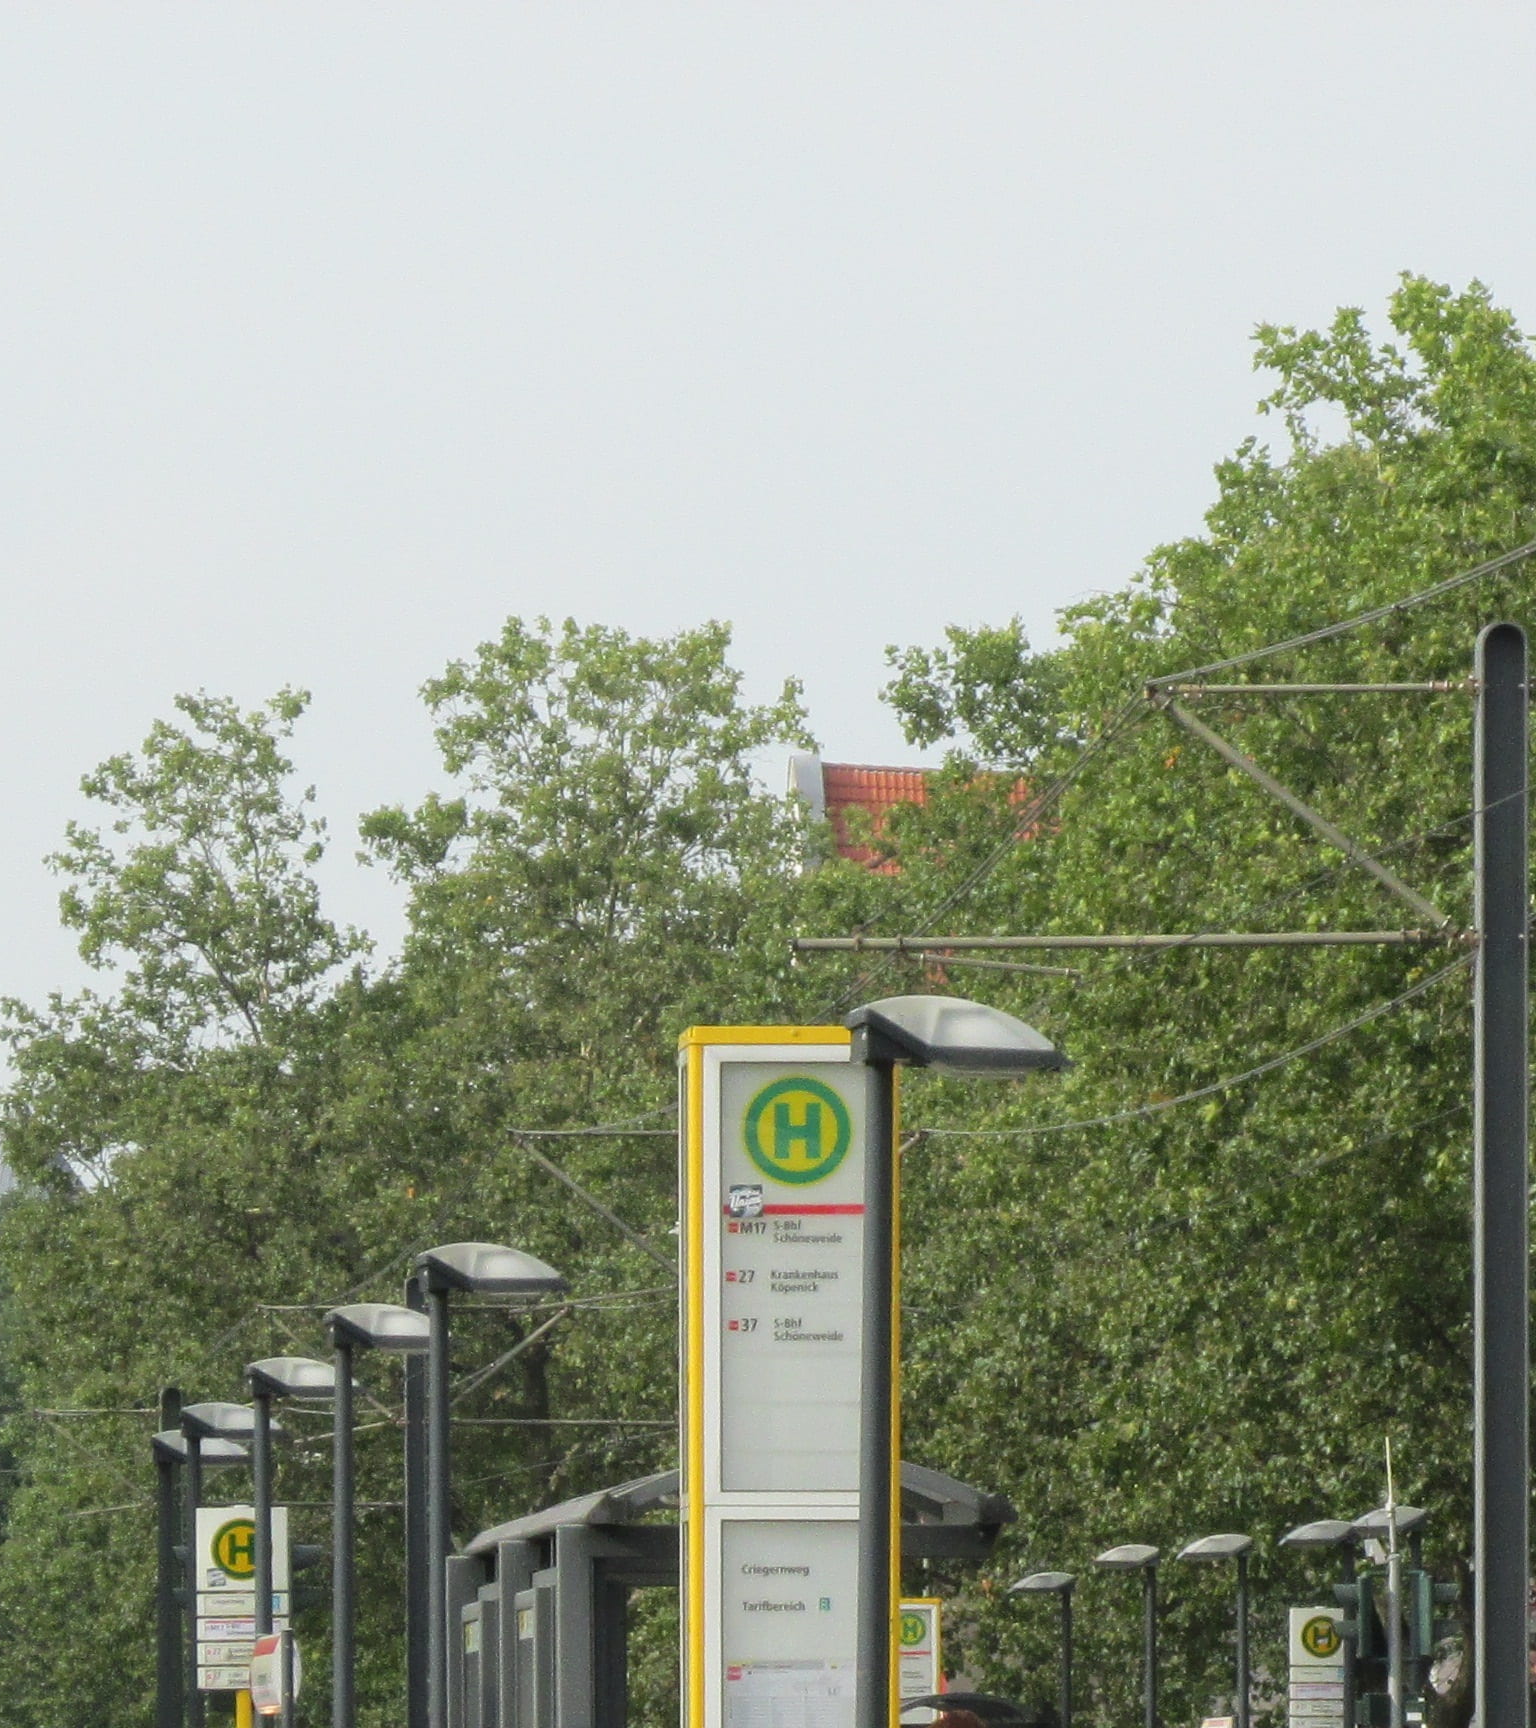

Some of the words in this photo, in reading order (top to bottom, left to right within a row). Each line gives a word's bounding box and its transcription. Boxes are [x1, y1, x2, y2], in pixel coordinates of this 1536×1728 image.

[774, 1102, 822, 1159] H
[740, 1222, 767, 1235] M17
[773, 1220, 802, 1230] S-Bhf
[773, 1232, 843, 1244] Schöneweide
[738, 1270, 756, 1284] 27
[770, 1269, 839, 1280] Krankenhaus
[771, 1281, 819, 1293] Köpenick
[741, 1318, 758, 1332] 37
[773, 1318, 802, 1328] S-Bhf
[774, 1330, 844, 1342] Schöneweide
[741, 1564, 810, 1577] Criegernweg
[743, 1600, 806, 1612] Tarifbereich
